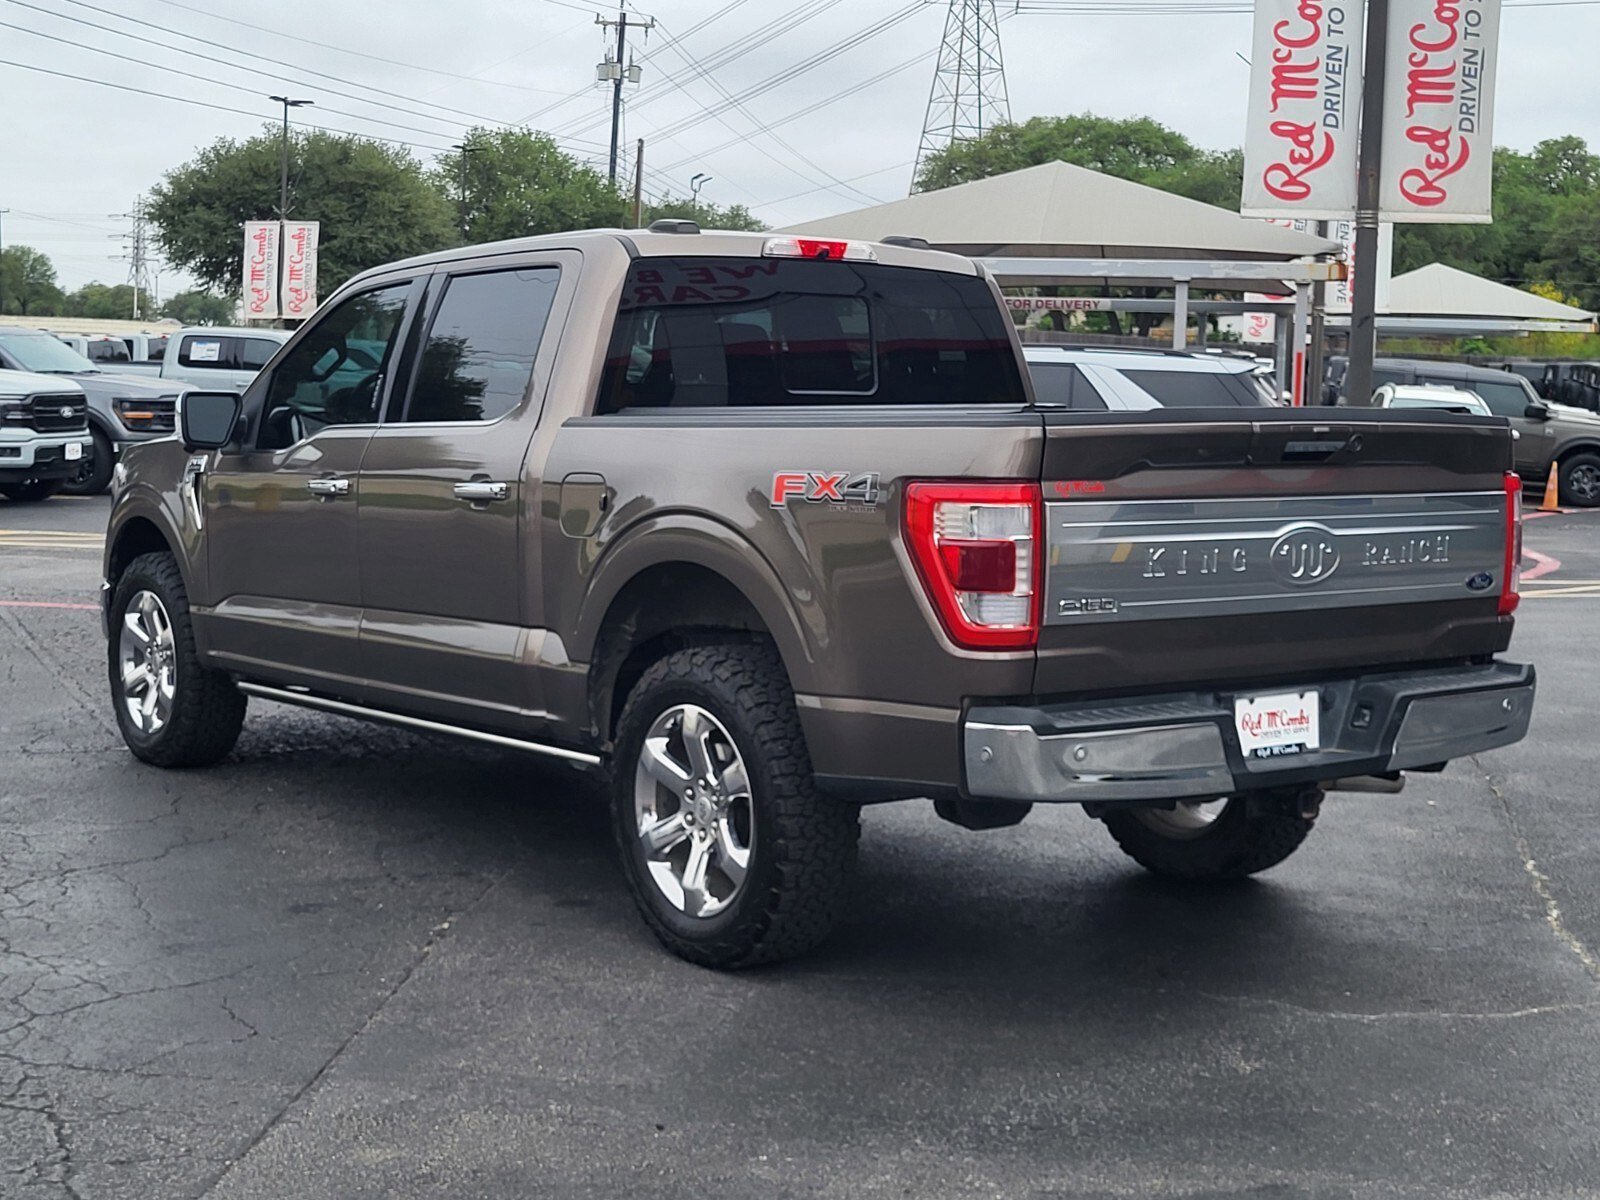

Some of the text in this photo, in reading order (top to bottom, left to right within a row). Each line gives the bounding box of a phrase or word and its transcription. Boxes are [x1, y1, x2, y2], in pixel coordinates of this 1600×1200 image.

[1269, 0, 1323, 113] McCo
[1323, 7, 1345, 129] DRIVEN TO
[1459, 9, 1482, 133] DRIVEN TO
[1399, 0, 1470, 207] Red McCo
[1263, 121, 1335, 201] Red
[250, 228, 269, 313] Red McCombs
[267, 251, 273, 262] TO
[289, 228, 308, 313] Red McCombs
[305, 251, 312, 262] TO
[1005, 299, 1100, 309] FOR DELIVERY
[769, 470, 880, 509] FX4
[1142, 548, 1246, 577] KING
[1362, 535, 1449, 565] RANCH
[1241, 708, 1310, 737] Red McCombs
